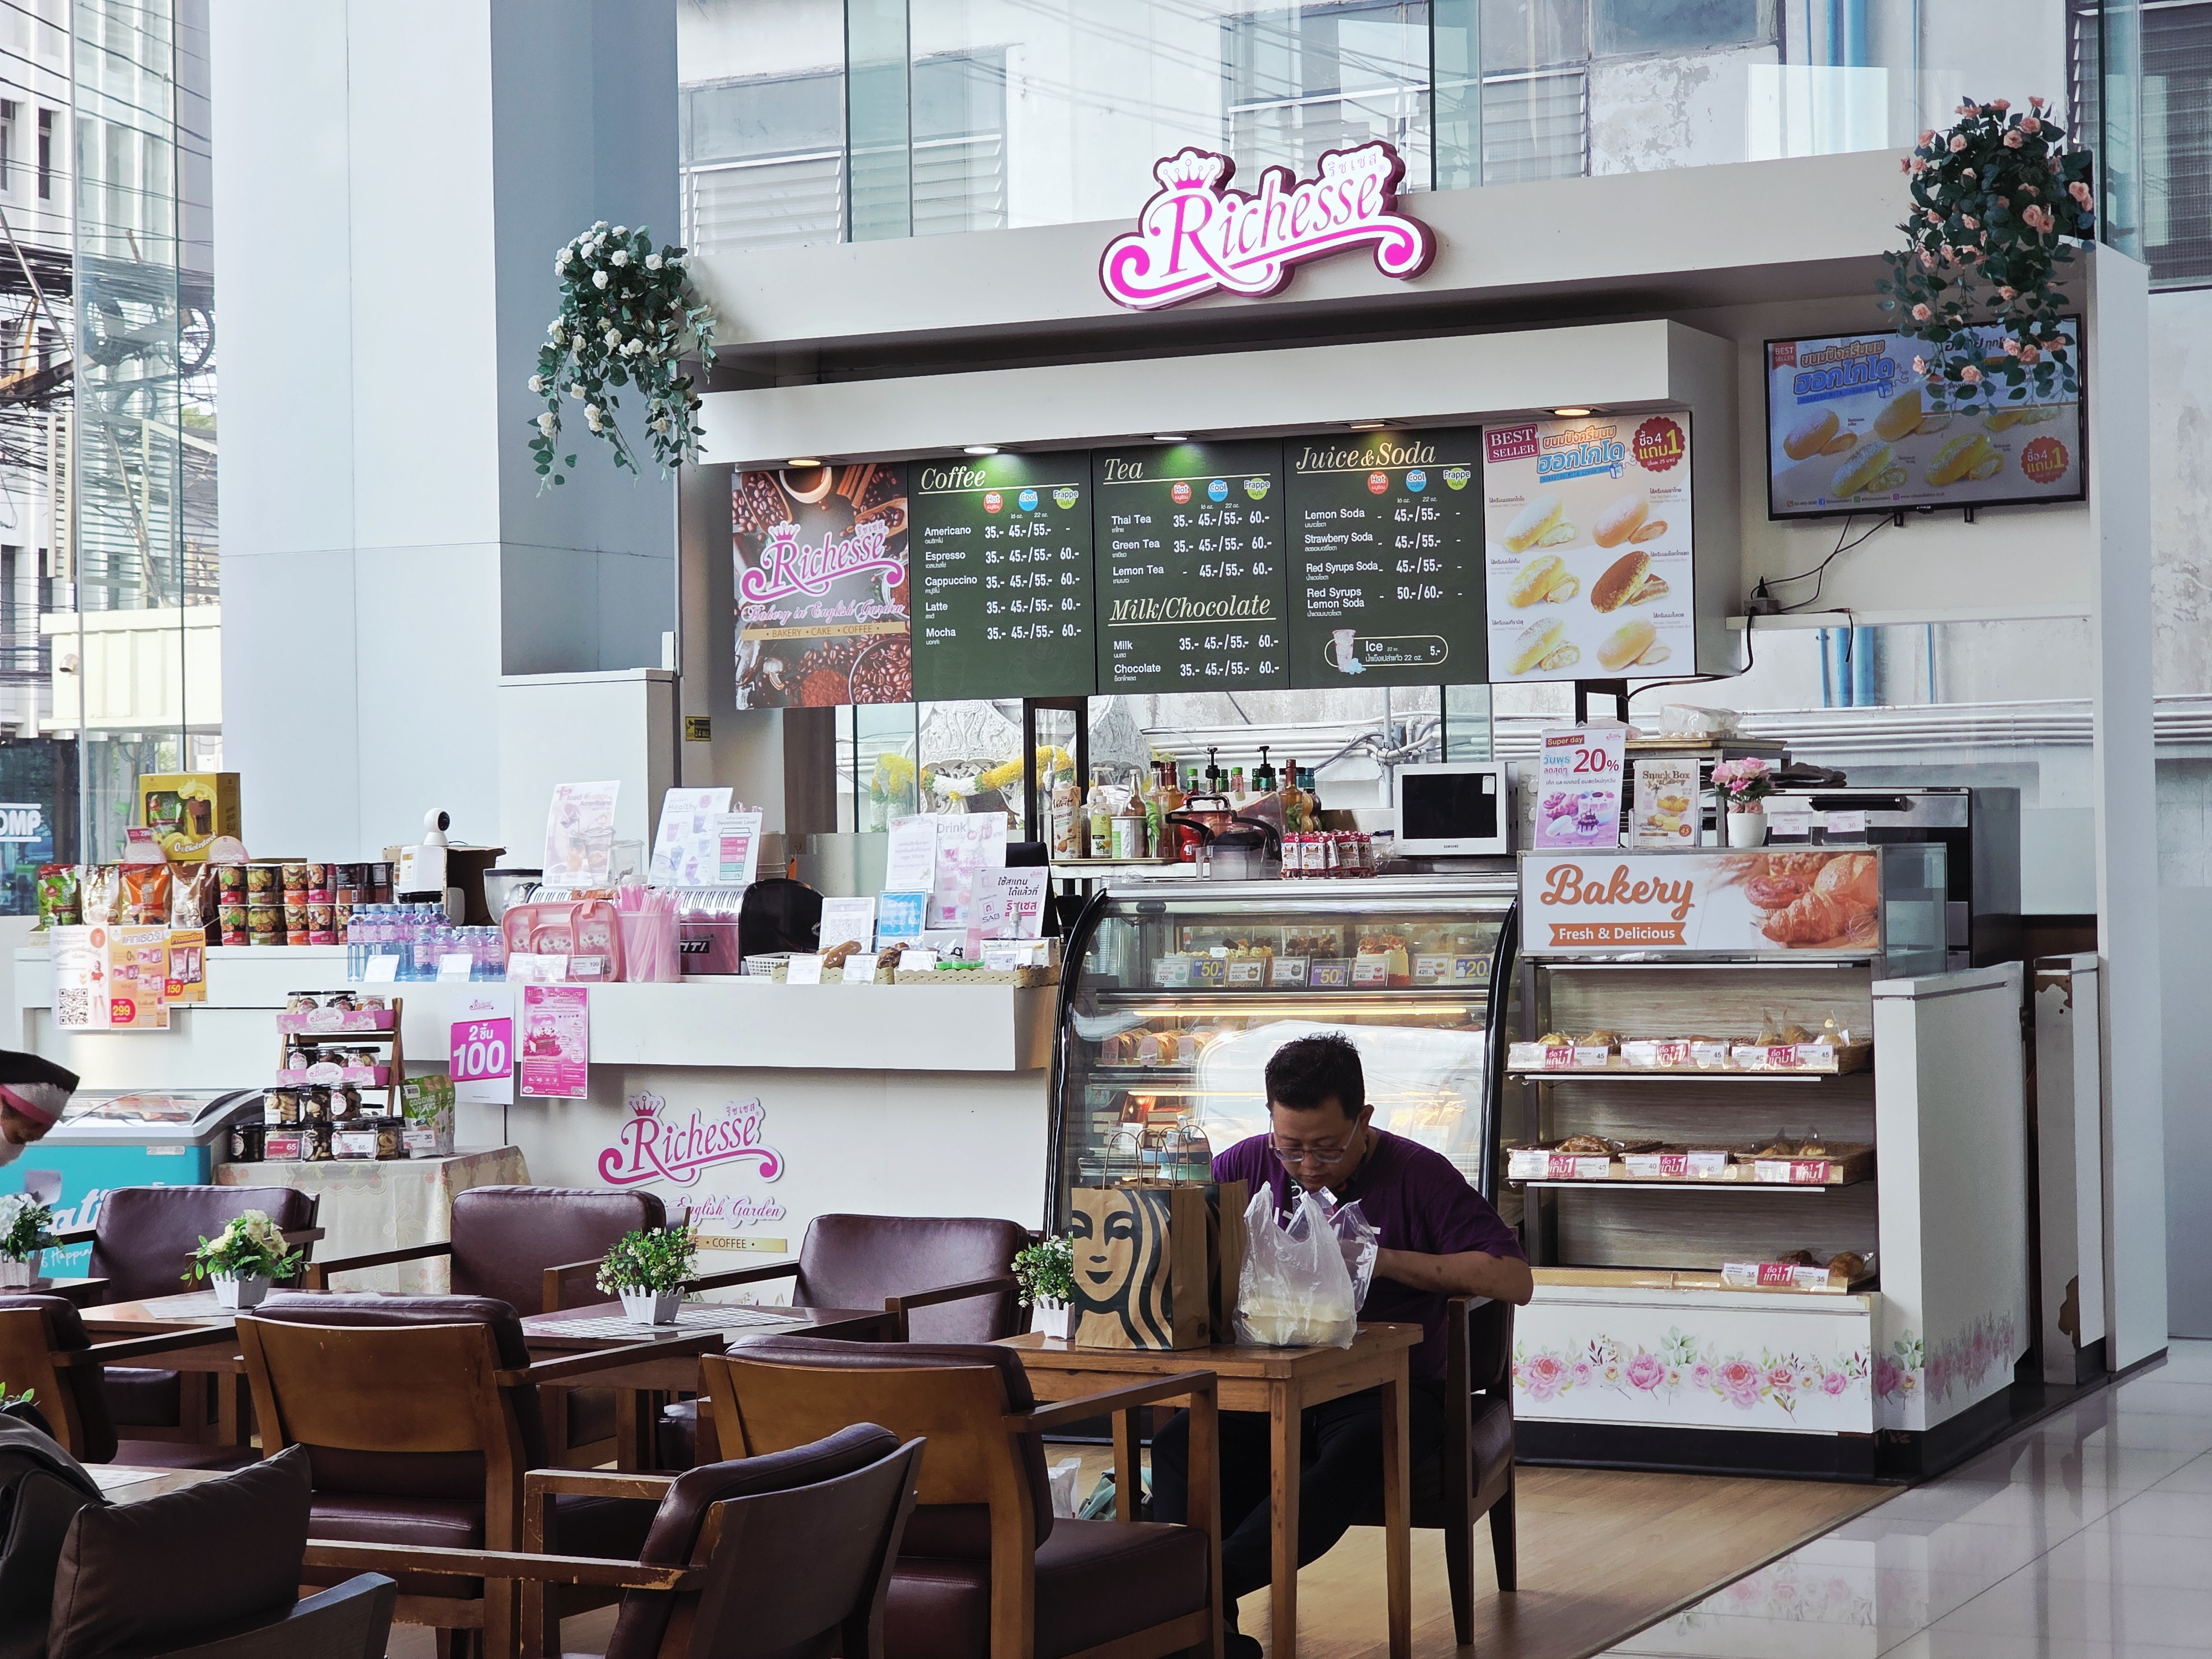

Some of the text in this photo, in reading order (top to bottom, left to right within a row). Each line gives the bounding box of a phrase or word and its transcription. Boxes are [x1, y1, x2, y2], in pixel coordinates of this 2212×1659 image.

[1149, 173, 1378, 285] Richesse
[1490, 429, 1533, 446] BEST
[1544, 425, 1616, 449] ขนมปังครีมนม
[1639, 431, 1662, 446] ซื้อ 4
[1639, 429, 1681, 459] แถม 1
[1493, 445, 1535, 458] SELLER
[1538, 442, 1624, 474] ฮอกไกโด
[1105, 458, 1143, 480] Tea
[921, 466, 985, 489] Coffee
[1444, 471, 1470, 479] Frappe
[1054, 491, 1078, 499] Frappe
[1174, 486, 1188, 494] Hot
[1305, 509, 1365, 519] Lemon Soda
[1112, 515, 1131, 525] Thai
[1134, 515, 1151, 523] Tea
[925, 527, 971, 536] Americano
[1305, 533, 1373, 544] Strawberry Soda
[1113, 540, 1139, 550] Green
[1142, 539, 1160, 548] Tea
[926, 552, 966, 562] Espresso
[763, 533, 885, 594] Richesse
[1307, 561, 1378, 573] Red Syrups Soda
[1113, 566, 1143, 576] Lemon
[1147, 565, 1164, 574] Tea
[925, 575, 977, 587] Cappuccino
[1307, 588, 1361, 598] Red Syrups
[926, 602, 948, 611] Latte
[1109, 595, 1270, 620] Milk/Chocolate
[1308, 598, 1364, 609] Lemon Soda
[926, 628, 956, 637] Mocha
[1114, 641, 1133, 650] Milk
[1366, 641, 1383, 652] Ice
[1114, 664, 1161, 673] Chocolate
[668, 802, 697, 810] Healthy
[938, 822, 967, 833] Drink
[1541, 864, 1695, 920] Bakery
[171, 932, 202, 944] Promotion
[1559, 926, 1675, 940] Fresh & Delicious
[166, 985, 180, 993] 150
[469, 1023, 493, 1041] 2 ชิ้น
[453, 1041, 505, 1076] 100
[621, 1113, 755, 1182] Richesse
[729, 1198, 780, 1219] Garden
[713, 1238, 747, 1248] COFFEE
